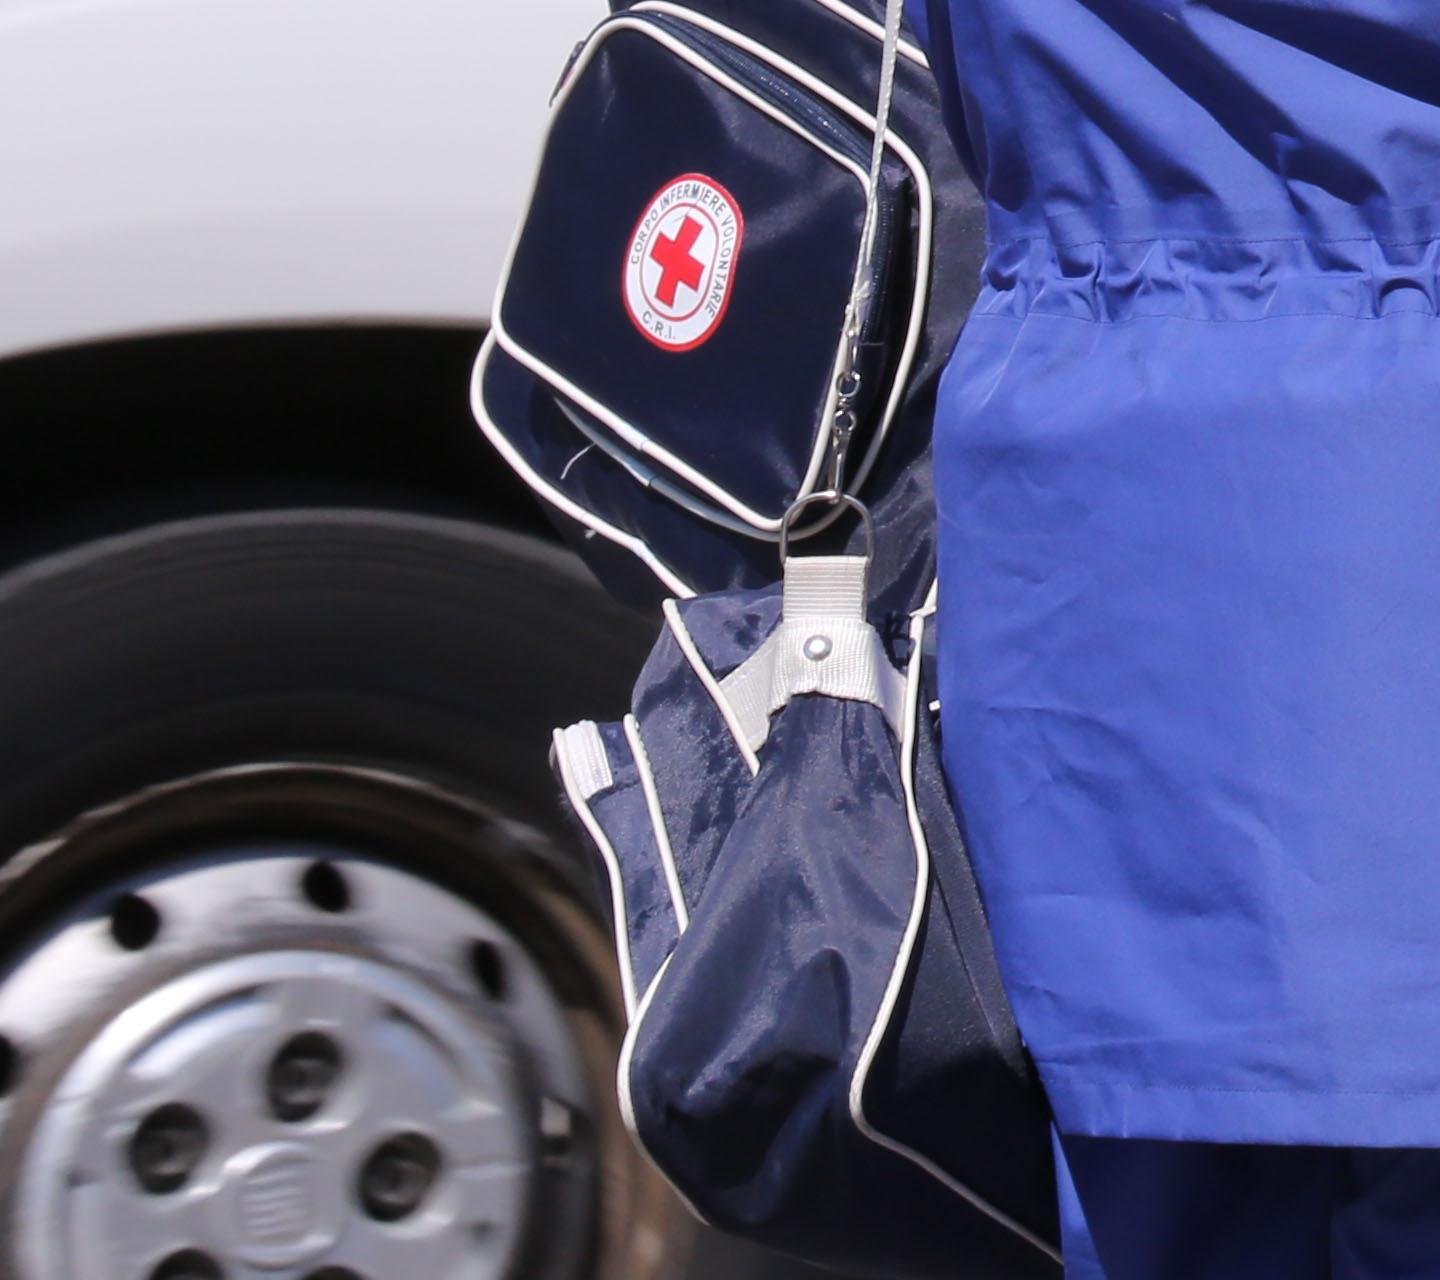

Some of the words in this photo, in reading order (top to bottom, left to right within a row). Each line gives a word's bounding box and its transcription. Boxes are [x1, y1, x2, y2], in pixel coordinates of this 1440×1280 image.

[631, 210, 659, 265] CORPO
[660, 183, 727, 217] INFERMIERE
[704, 215, 736, 318] VOLONTARIE
